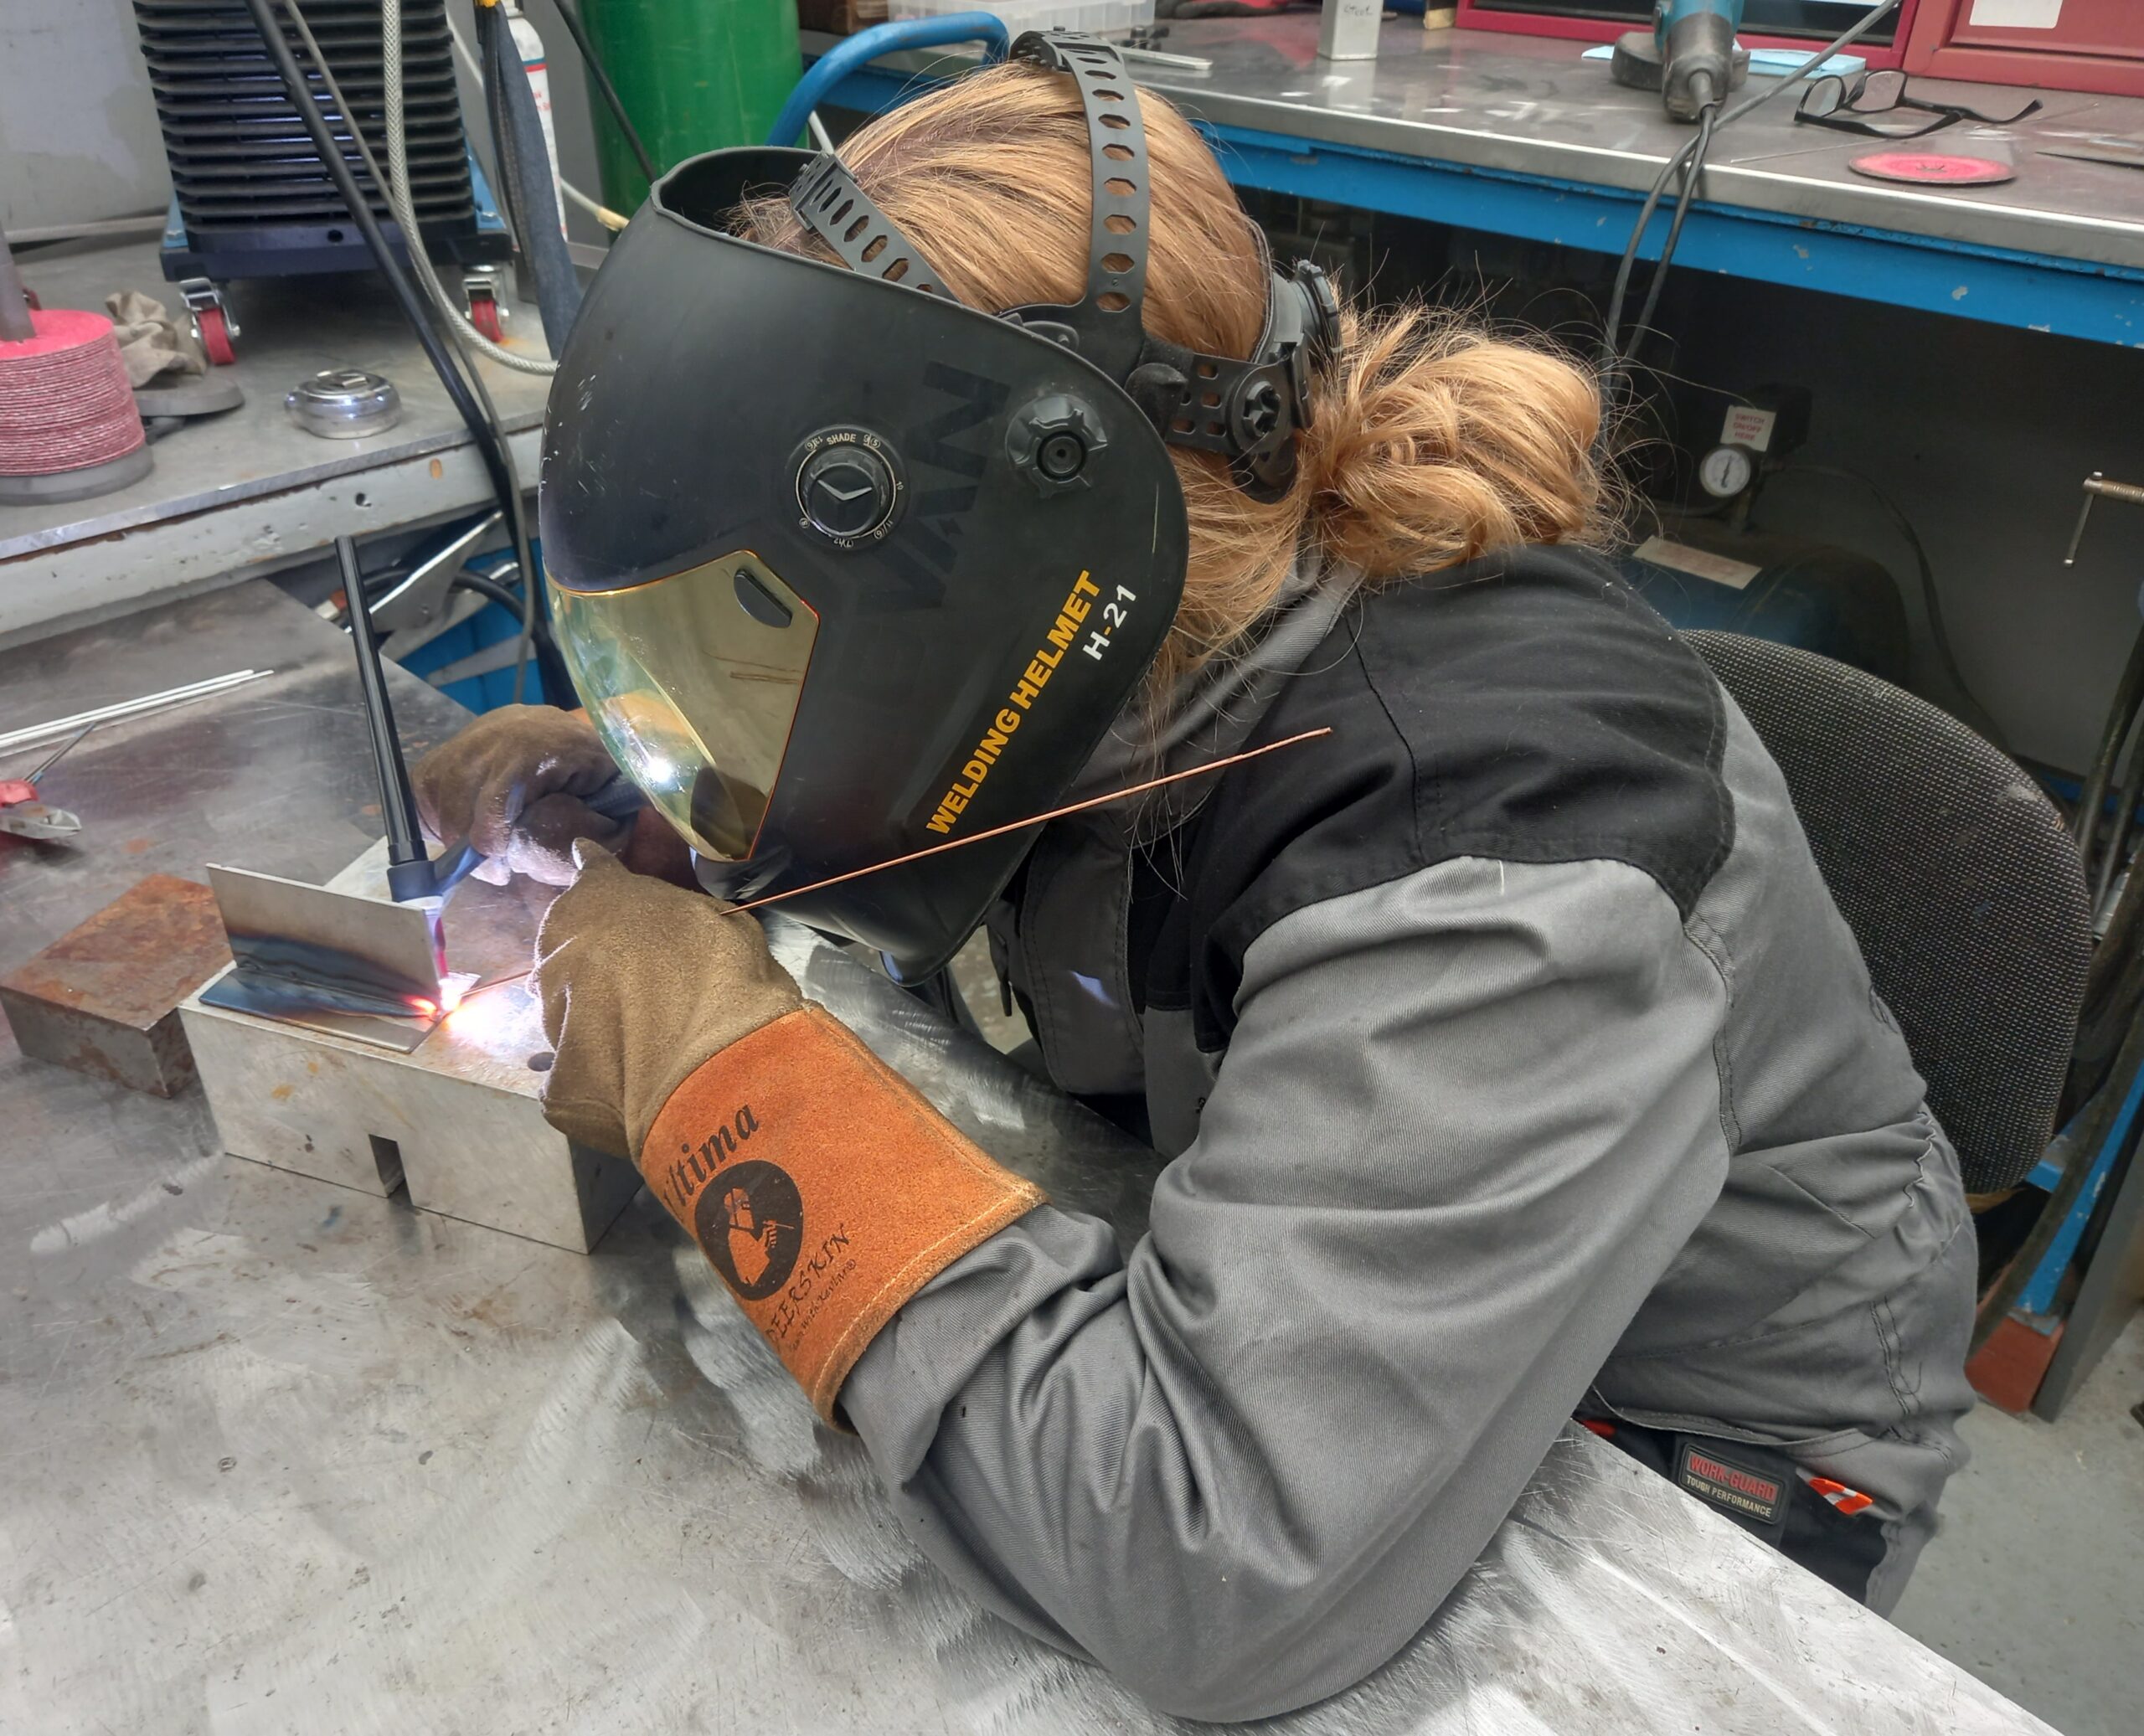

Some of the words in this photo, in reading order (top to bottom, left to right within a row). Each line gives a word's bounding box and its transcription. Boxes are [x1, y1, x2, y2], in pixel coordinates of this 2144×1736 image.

[826, 432, 857, 445] SHADE
[1082, 584, 1137, 661] H-21
[925, 708, 1021, 835] WELDING
[1009, 569, 1100, 710] HELMET
[1686, 1474, 1711, 1495] TOUGH
[1711, 1486, 1773, 1518] PERFORMANCE
[1689, 1455, 1778, 1502] WORK-GUARD
